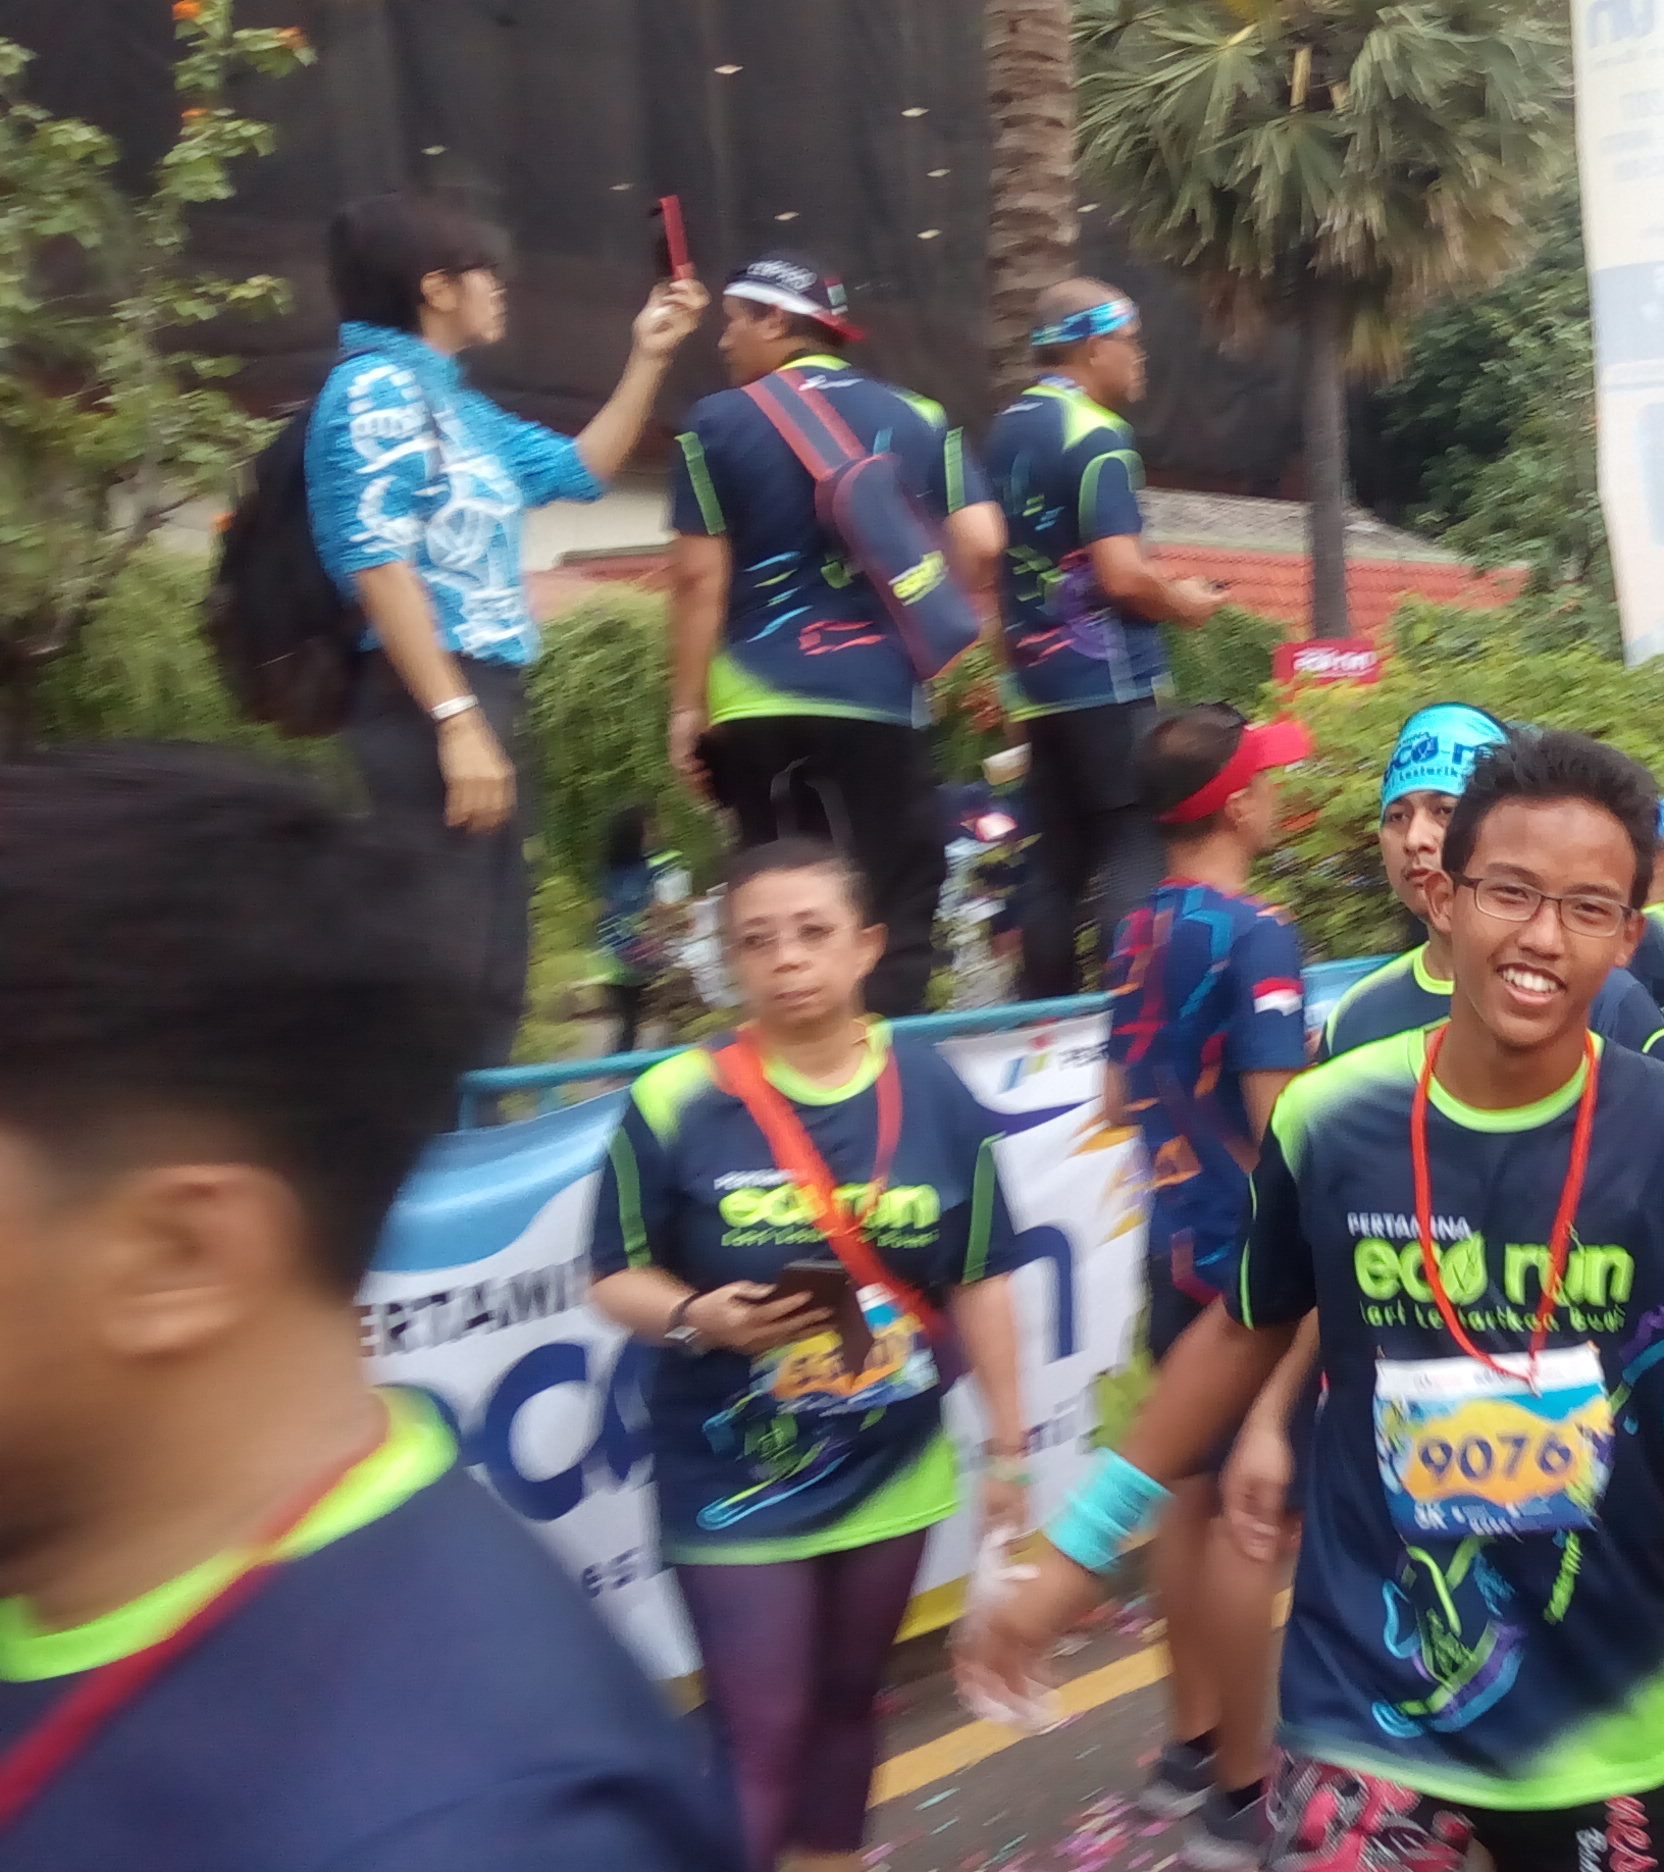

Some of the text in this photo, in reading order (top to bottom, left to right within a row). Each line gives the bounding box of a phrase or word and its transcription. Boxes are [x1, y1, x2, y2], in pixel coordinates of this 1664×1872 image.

[1354, 1230, 1634, 1307] eco run
[1414, 1302, 1560, 1332] Letarikan
[1418, 1432, 1573, 1482] 9076
